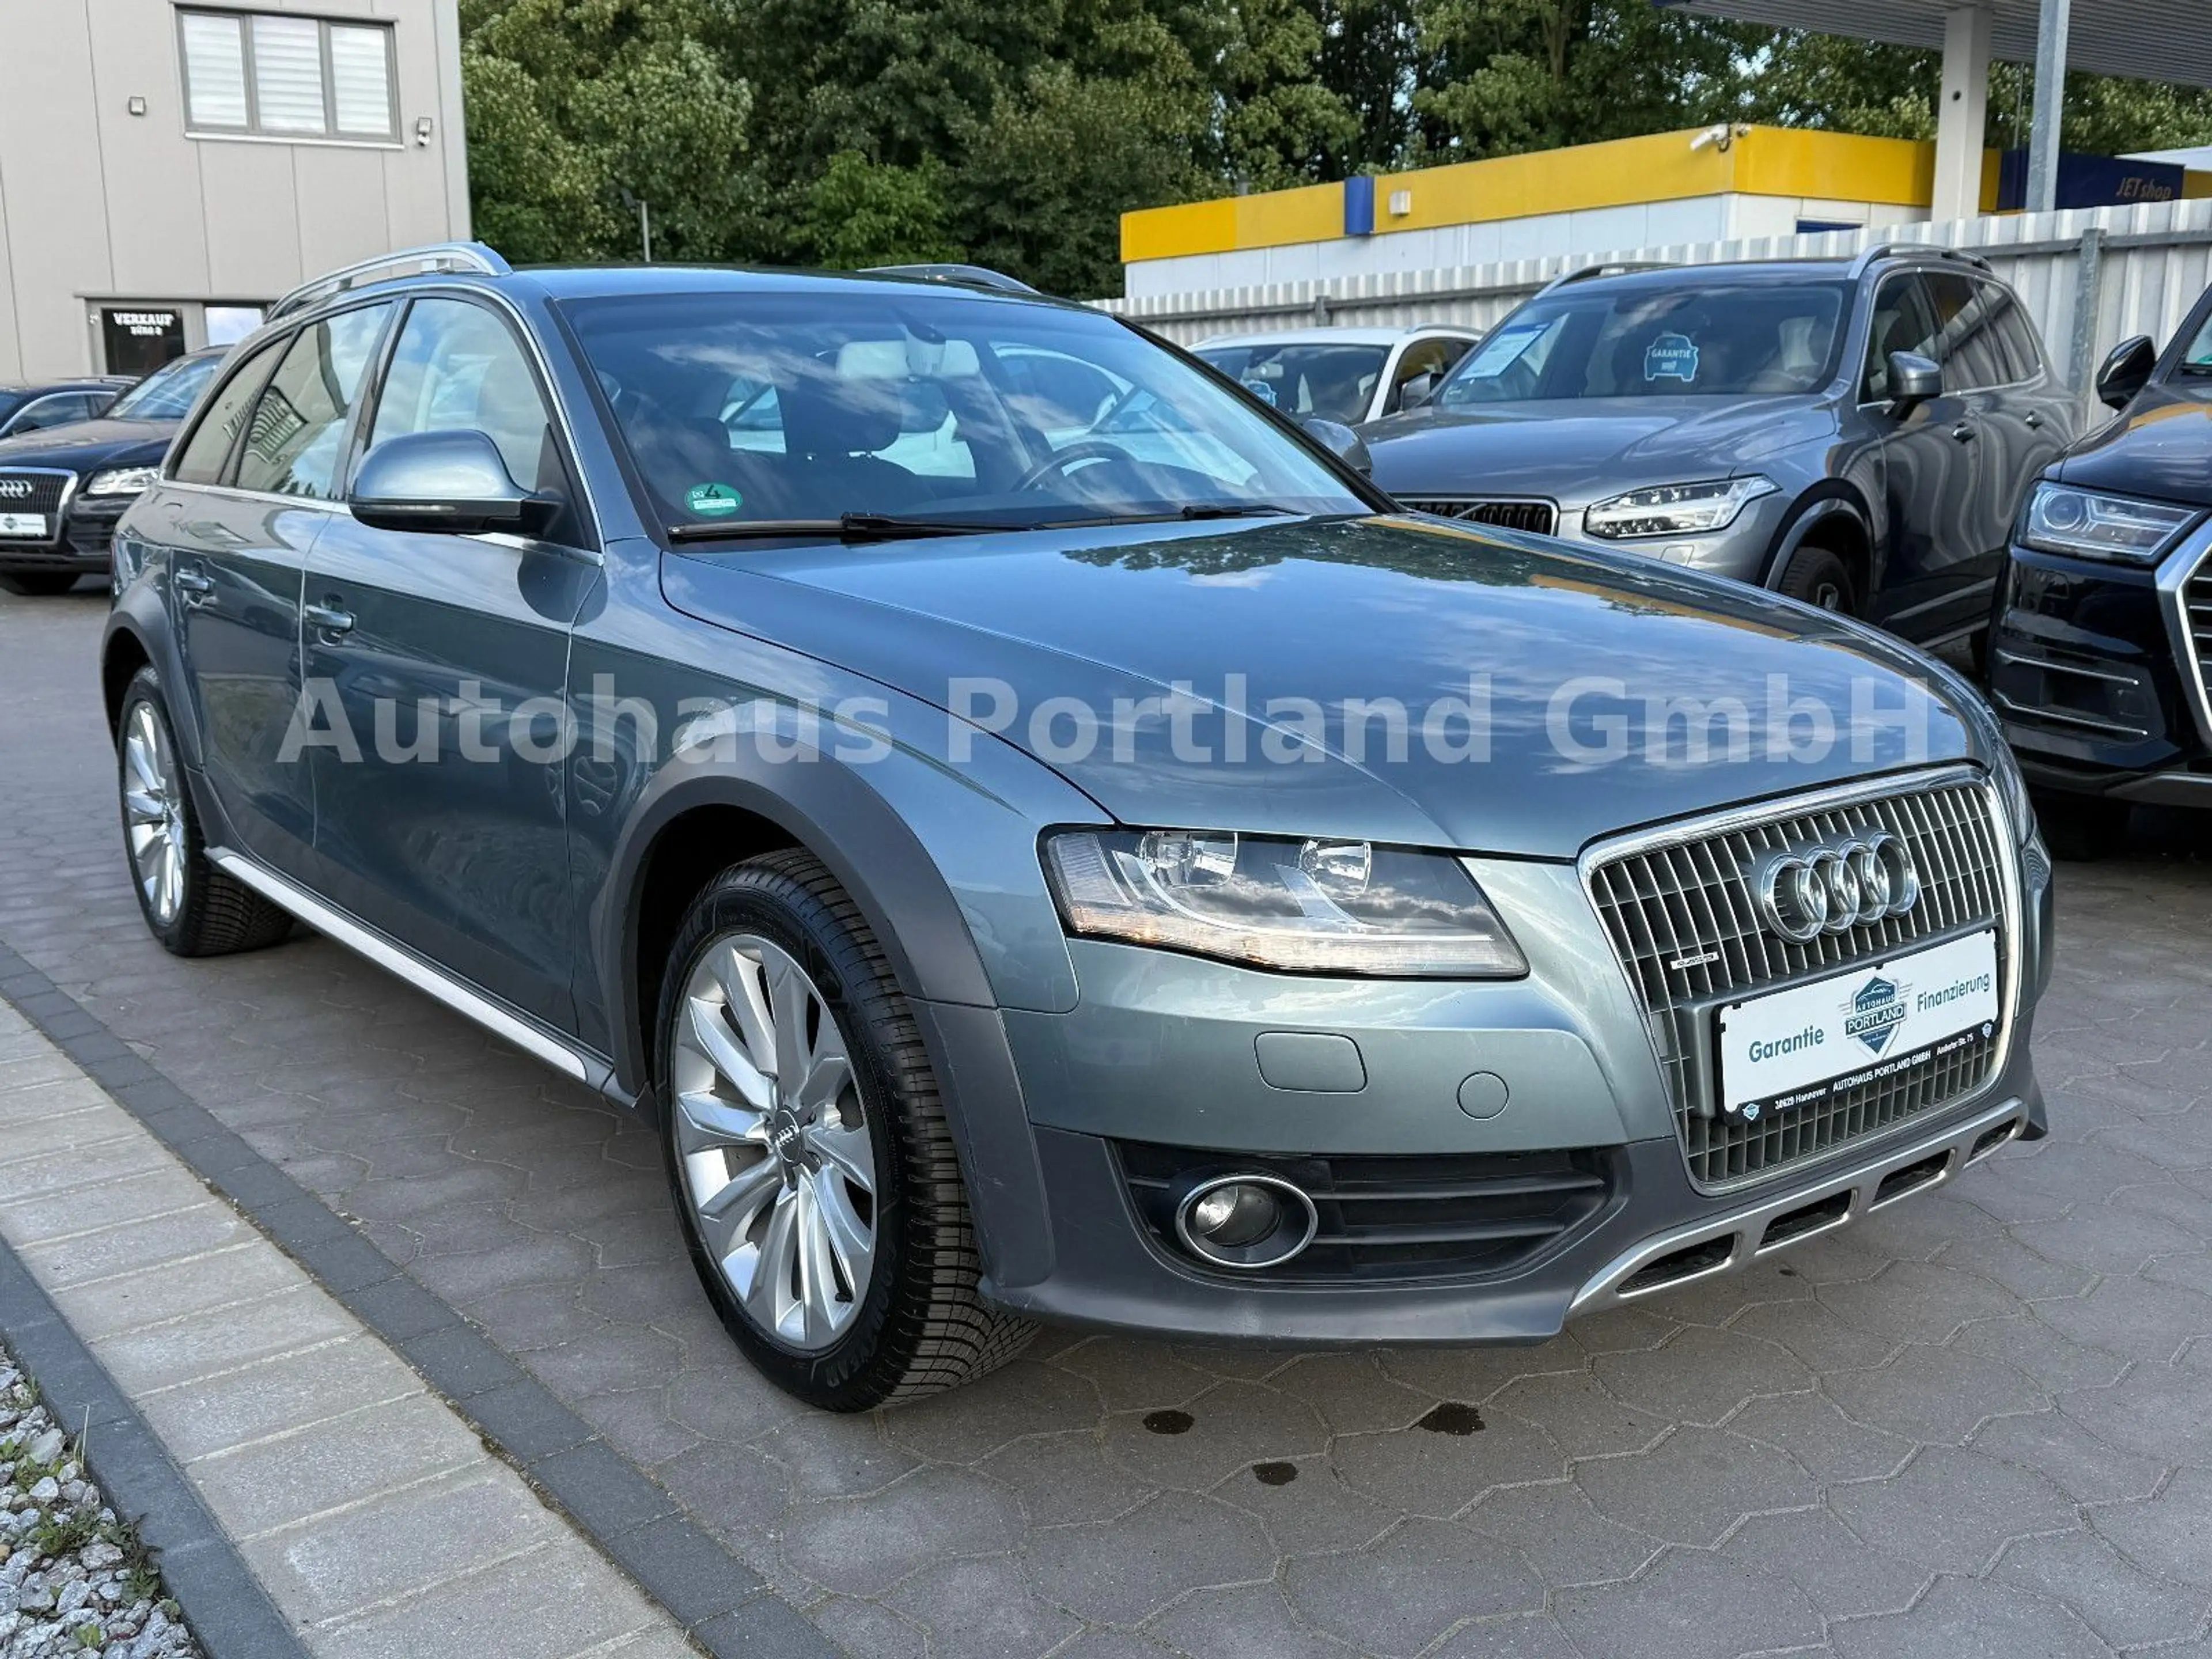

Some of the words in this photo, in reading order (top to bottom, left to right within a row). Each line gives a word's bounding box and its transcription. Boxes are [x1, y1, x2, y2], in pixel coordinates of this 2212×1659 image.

[2115, 177, 2143, 198] JET
[2140, 178, 2172, 200] shop
[704, 484, 721, 499] 4
[1857, 994, 1895, 1012] AUTOHAUS
[1917, 973, 1990, 1013] Finanzierung
[1847, 1006, 1904, 1032] PORTLAND
[1748, 1025, 1825, 1063] Garantie
[1833, 1071, 1874, 1093] AUTOHAUS
[1874, 1057, 1911, 1078] PORTLAND
